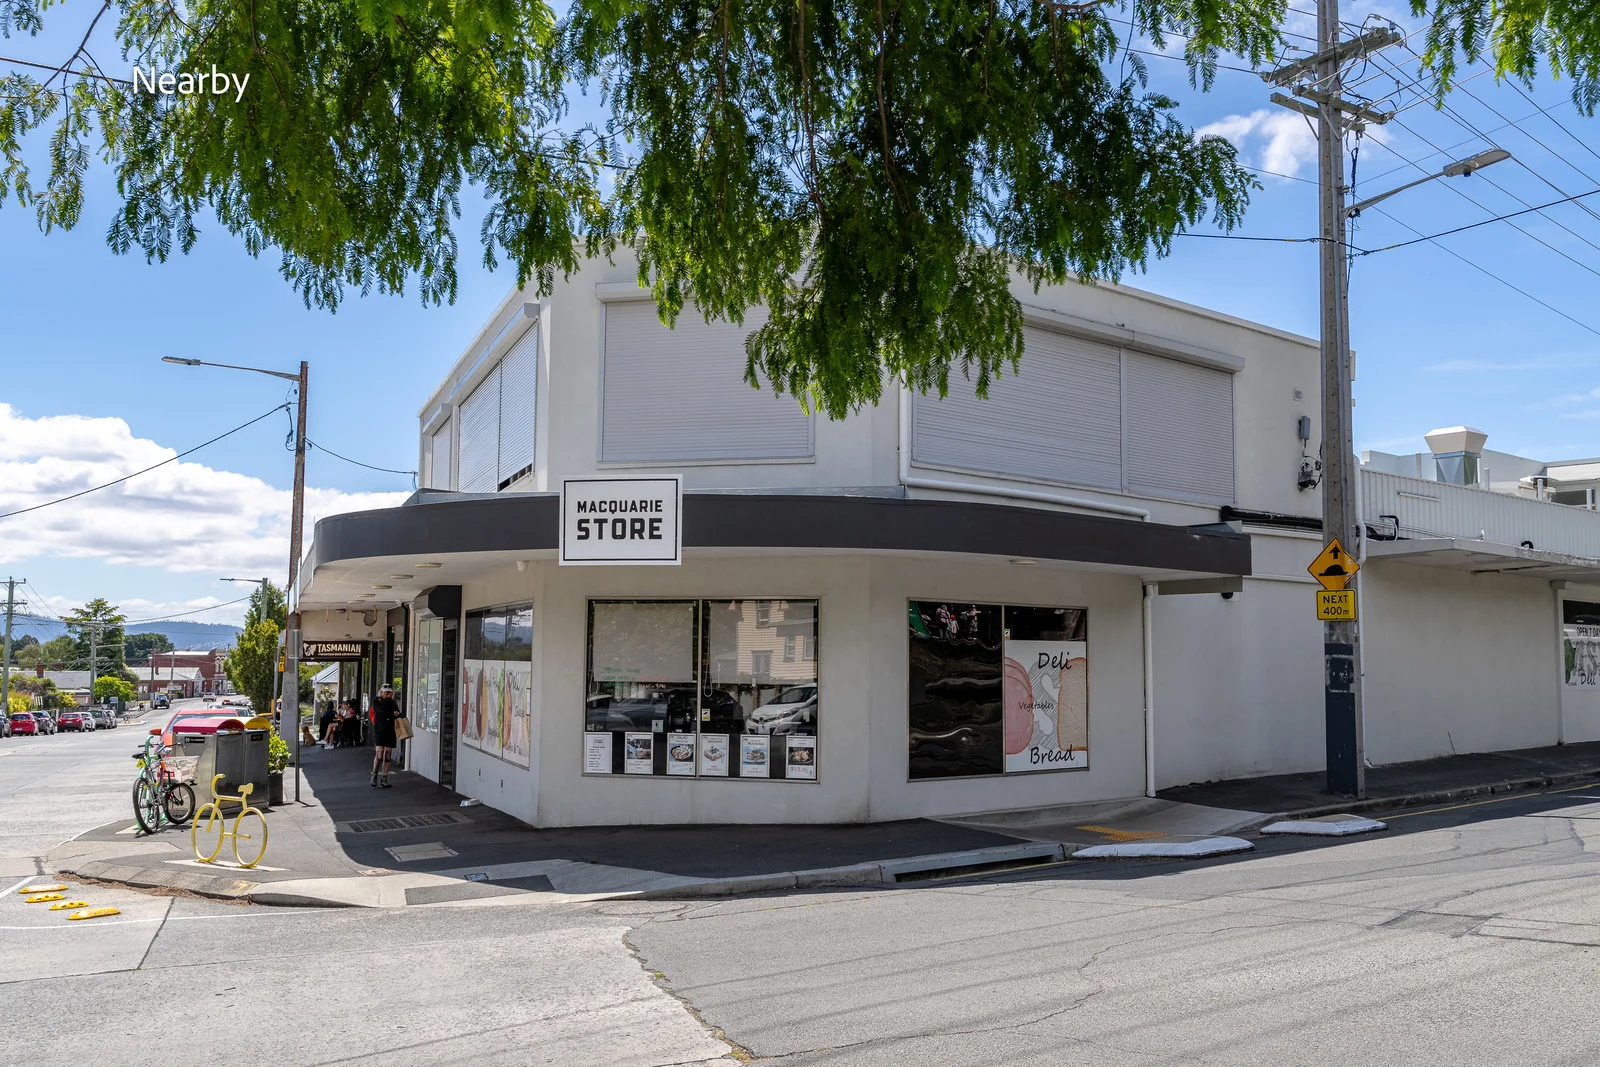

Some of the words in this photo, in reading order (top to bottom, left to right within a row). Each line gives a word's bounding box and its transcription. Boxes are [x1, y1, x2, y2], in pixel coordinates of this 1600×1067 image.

[577, 500, 663, 514] MACQUARIE
[577, 518, 663, 540] STORE
[1323, 595, 1349, 604] NEXT
[1323, 606, 1349, 615] 400m
[1577, 626, 1588, 637] OPEN
[318, 644, 362, 653] TASMANIAN
[1038, 651, 1072, 670] Deli
[1580, 673, 1596, 686] Deli
[1018, 700, 1055, 712] Vegetables
[1030, 744, 1075, 765] Bread
